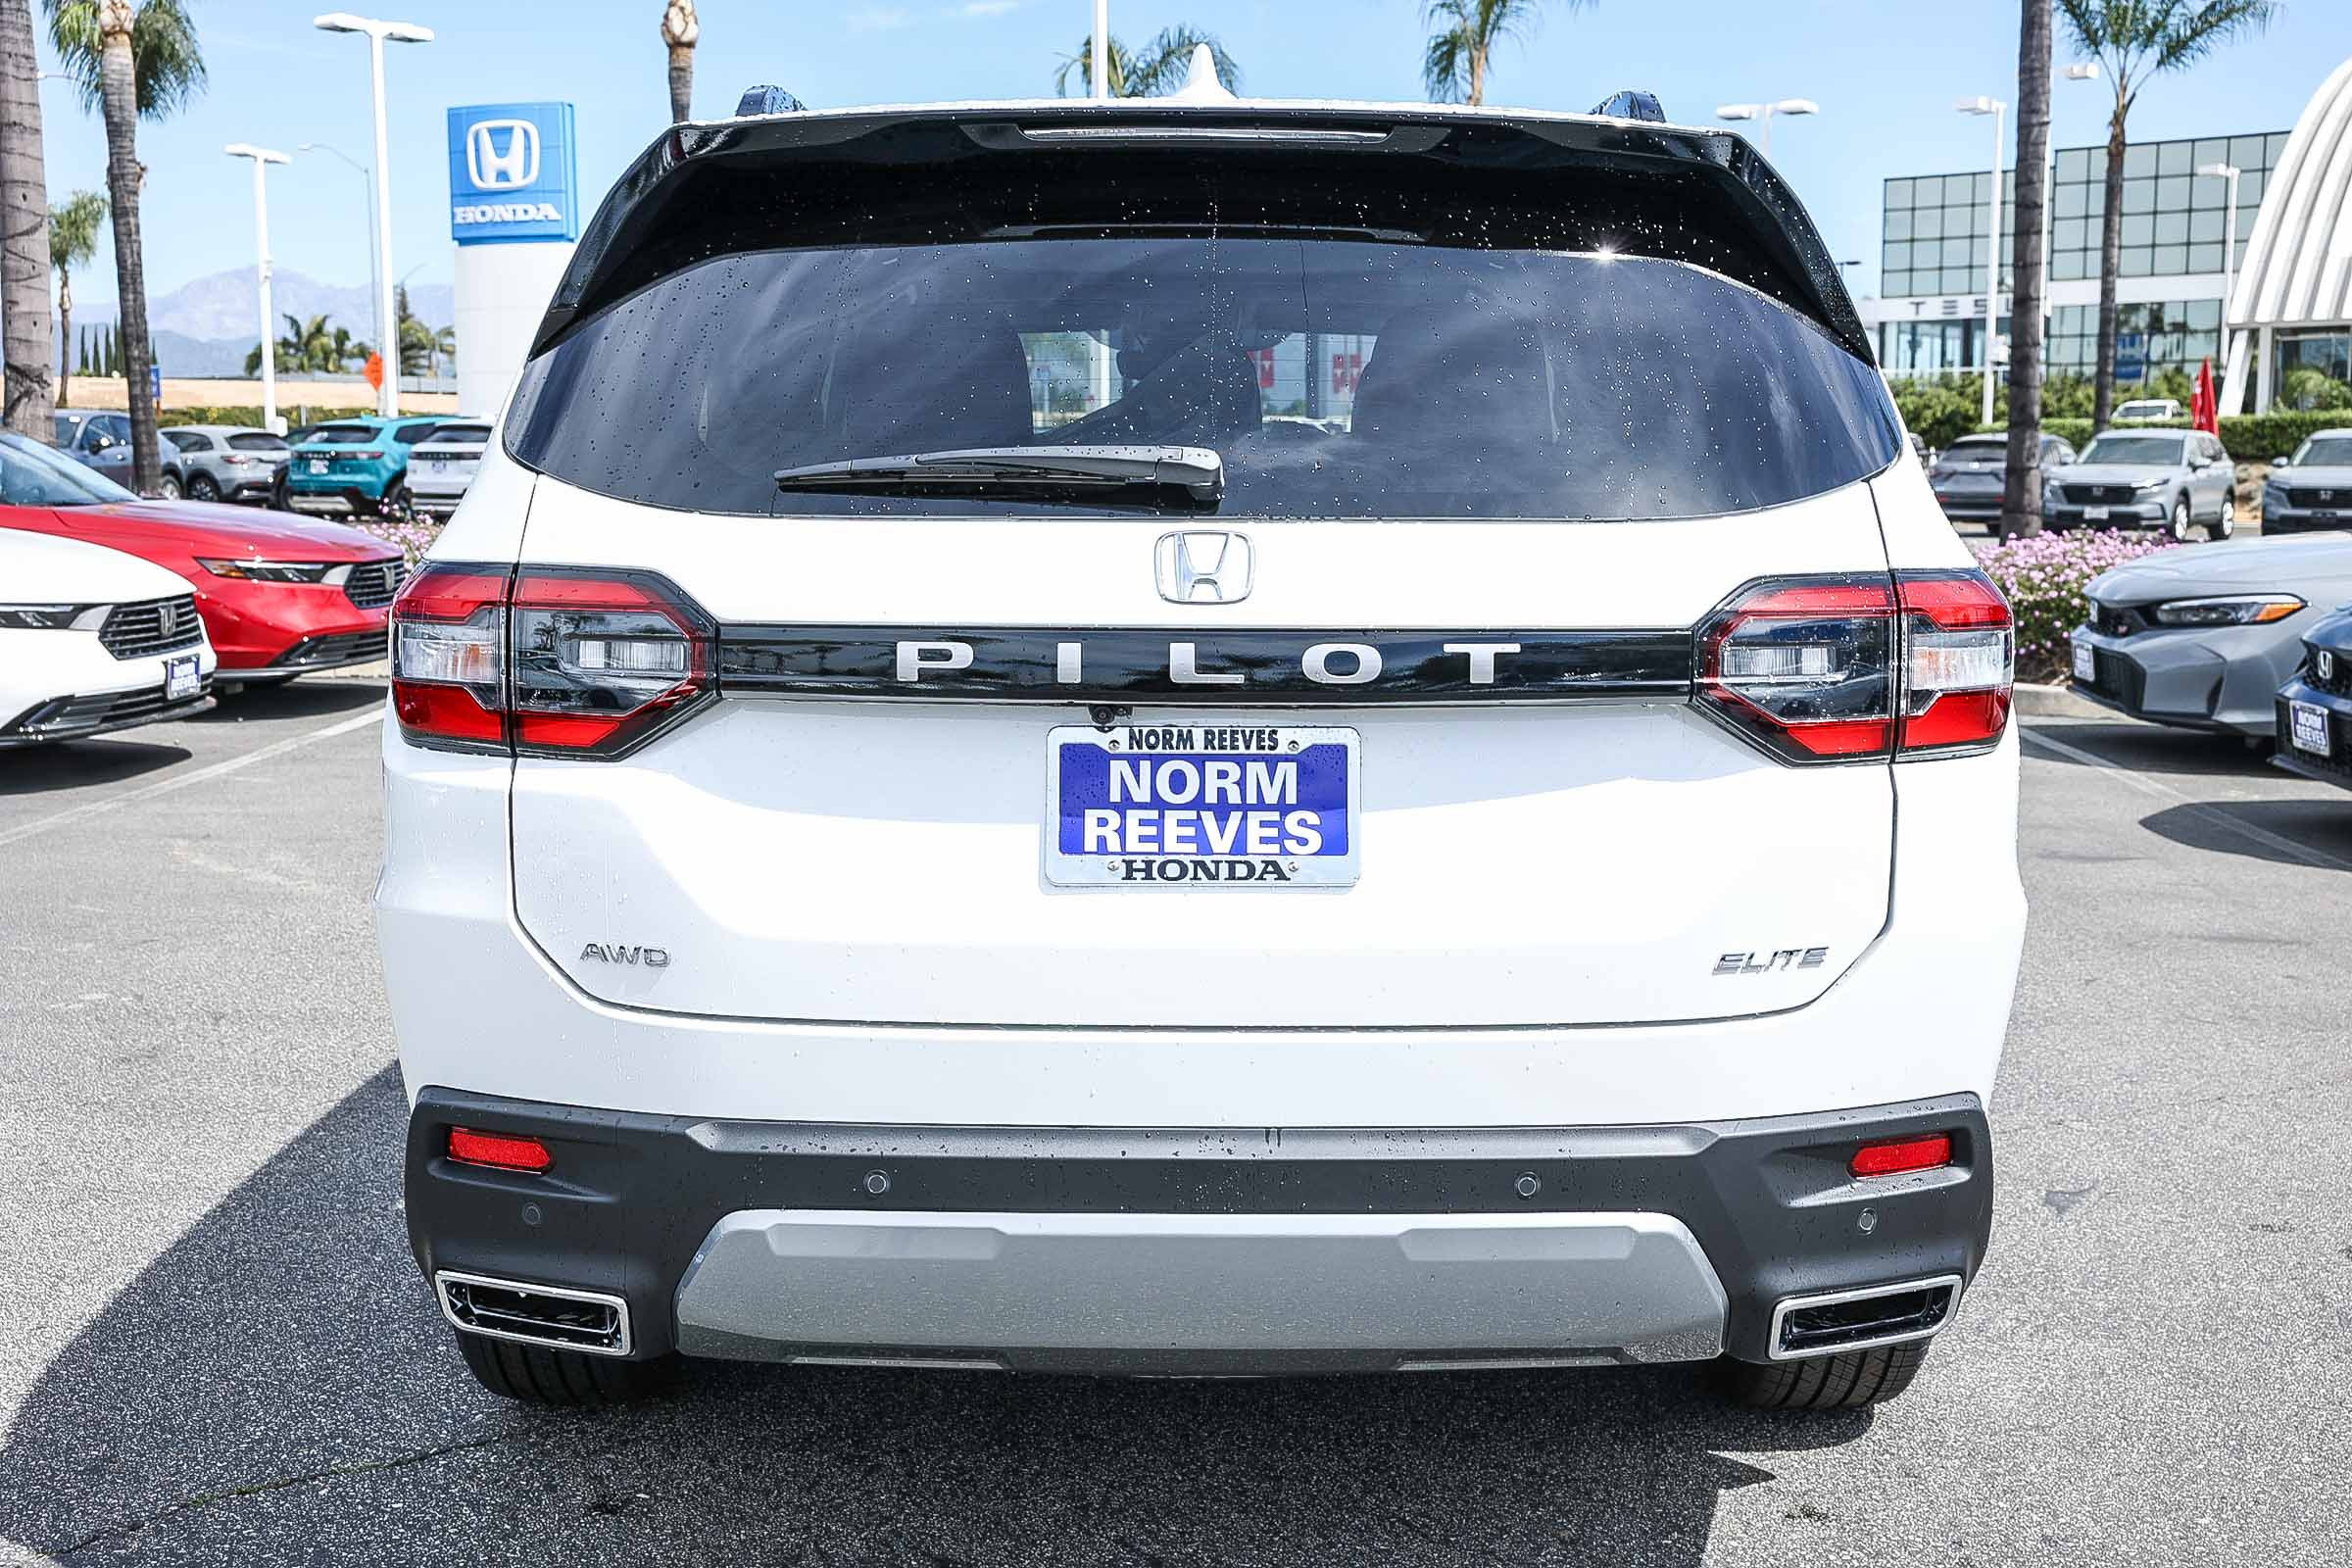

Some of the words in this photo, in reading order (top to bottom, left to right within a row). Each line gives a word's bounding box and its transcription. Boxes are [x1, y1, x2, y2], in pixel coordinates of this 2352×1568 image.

[454, 203, 562, 224] HONDA
[1908, 298, 2013, 316] TESL
[896, 641, 1521, 685] PILOT
[1128, 728, 1196, 751] NORM
[1203, 728, 1279, 752] REEVES
[1108, 760, 1298, 806] NORM
[1082, 808, 1323, 856] REEVES
[1121, 858, 1292, 882] HONDA
[580, 943, 669, 967] AWD
[1711, 946, 1829, 975] ELITE
